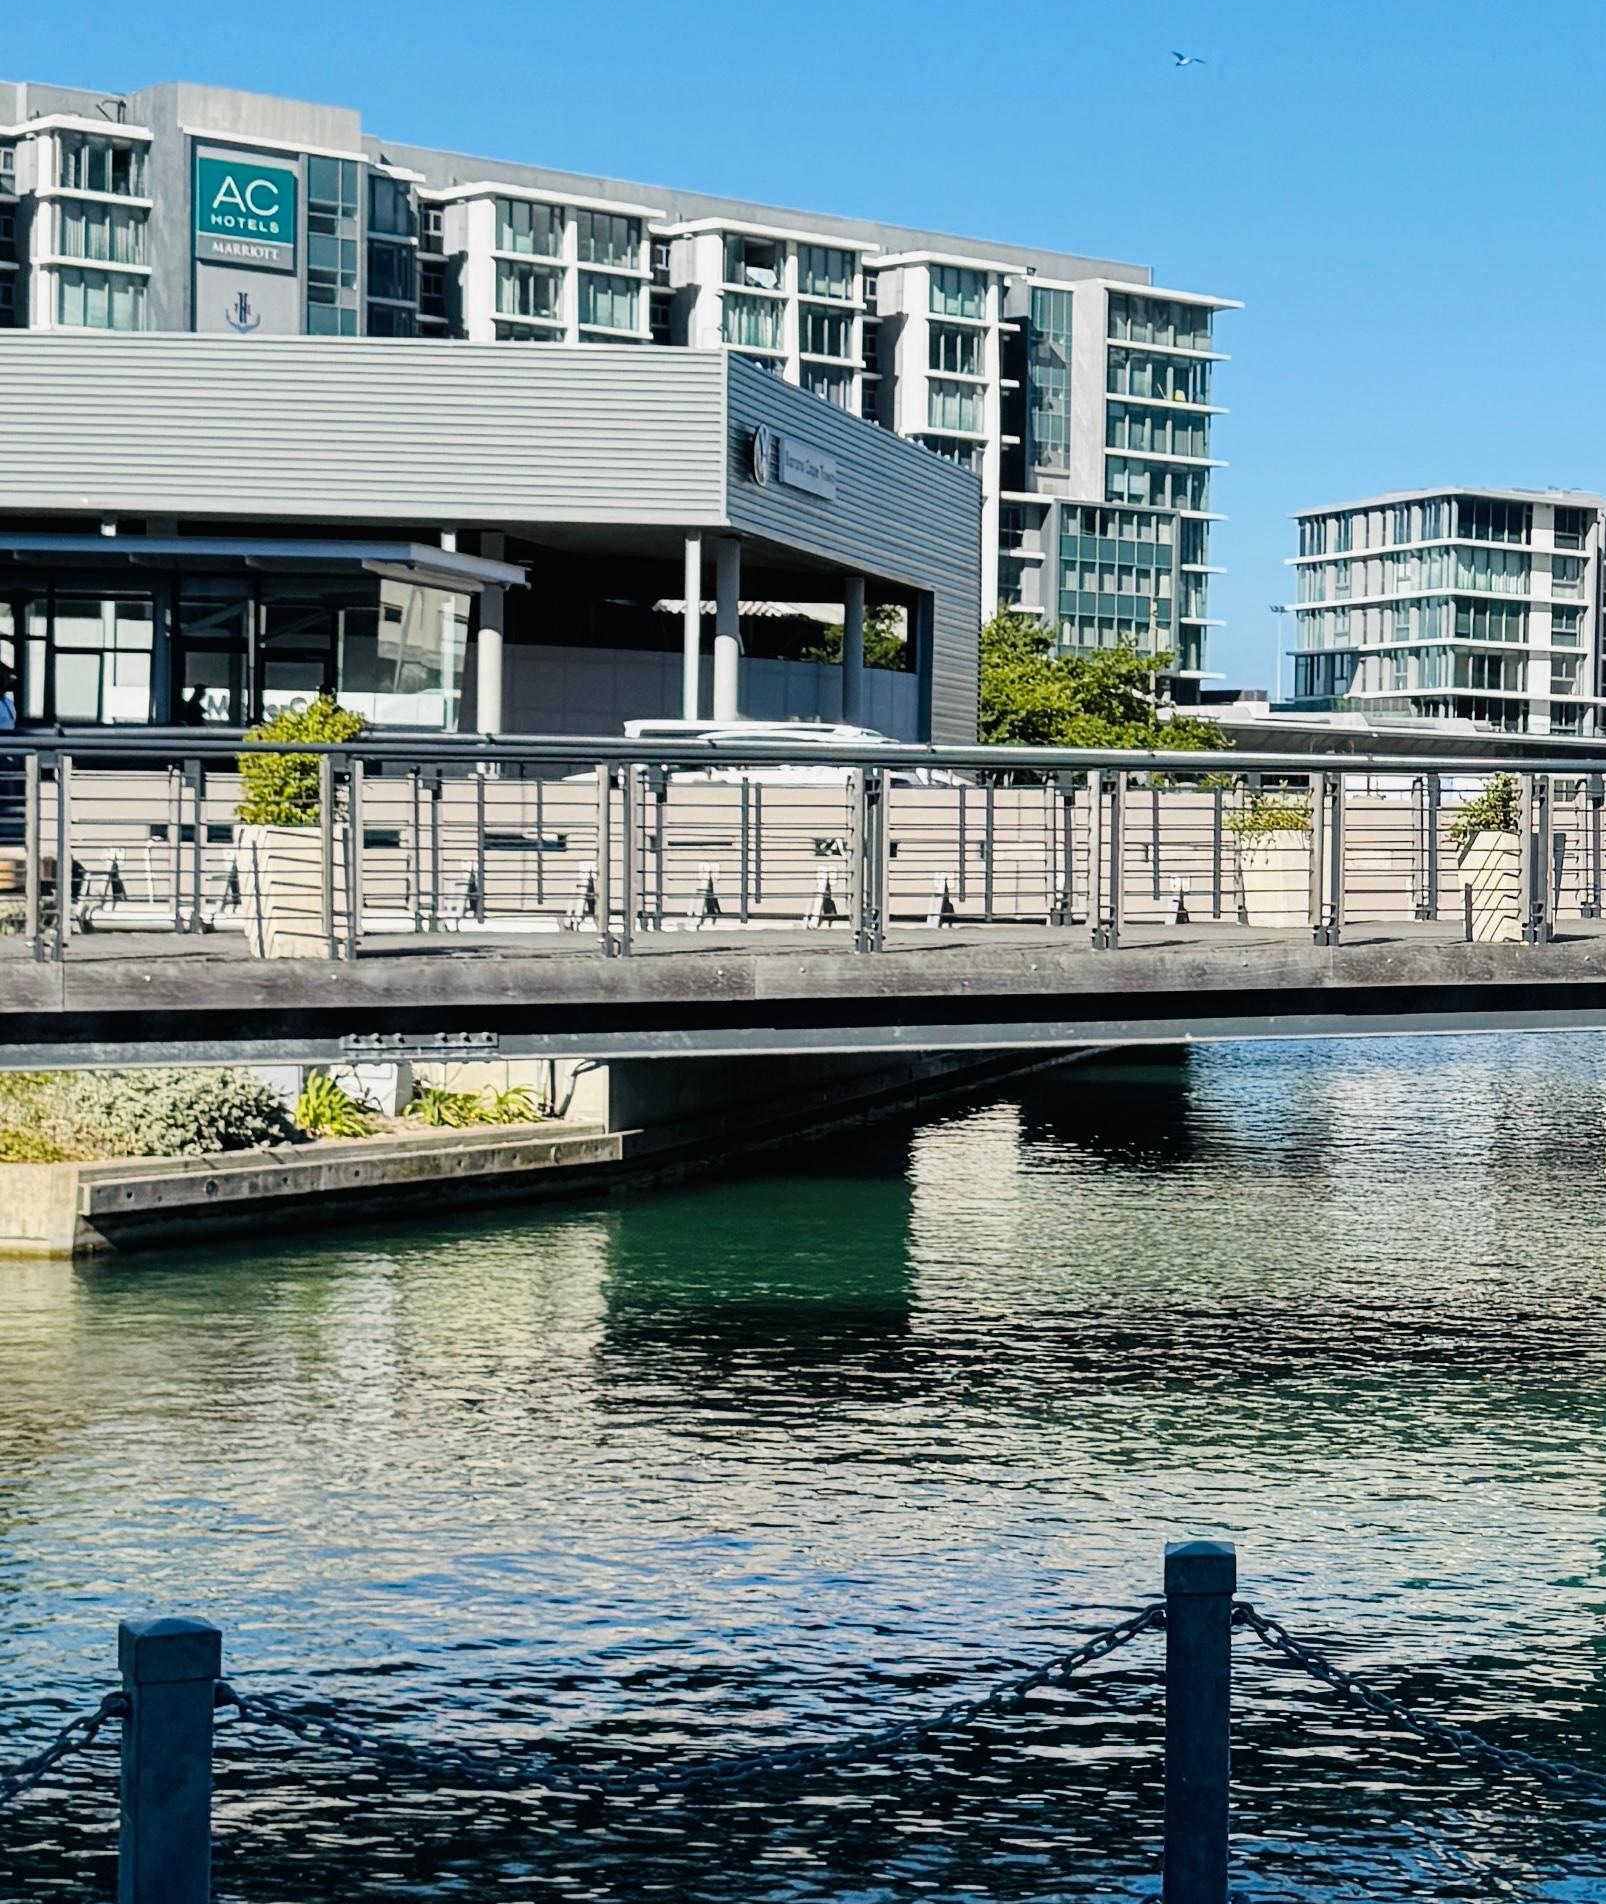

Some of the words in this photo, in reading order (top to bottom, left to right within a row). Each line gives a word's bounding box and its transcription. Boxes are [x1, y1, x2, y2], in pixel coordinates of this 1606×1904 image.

[212, 175, 280, 217] AC
[210, 213, 280, 234] HOTELS
[212, 241, 280, 261] MARRIOTT
